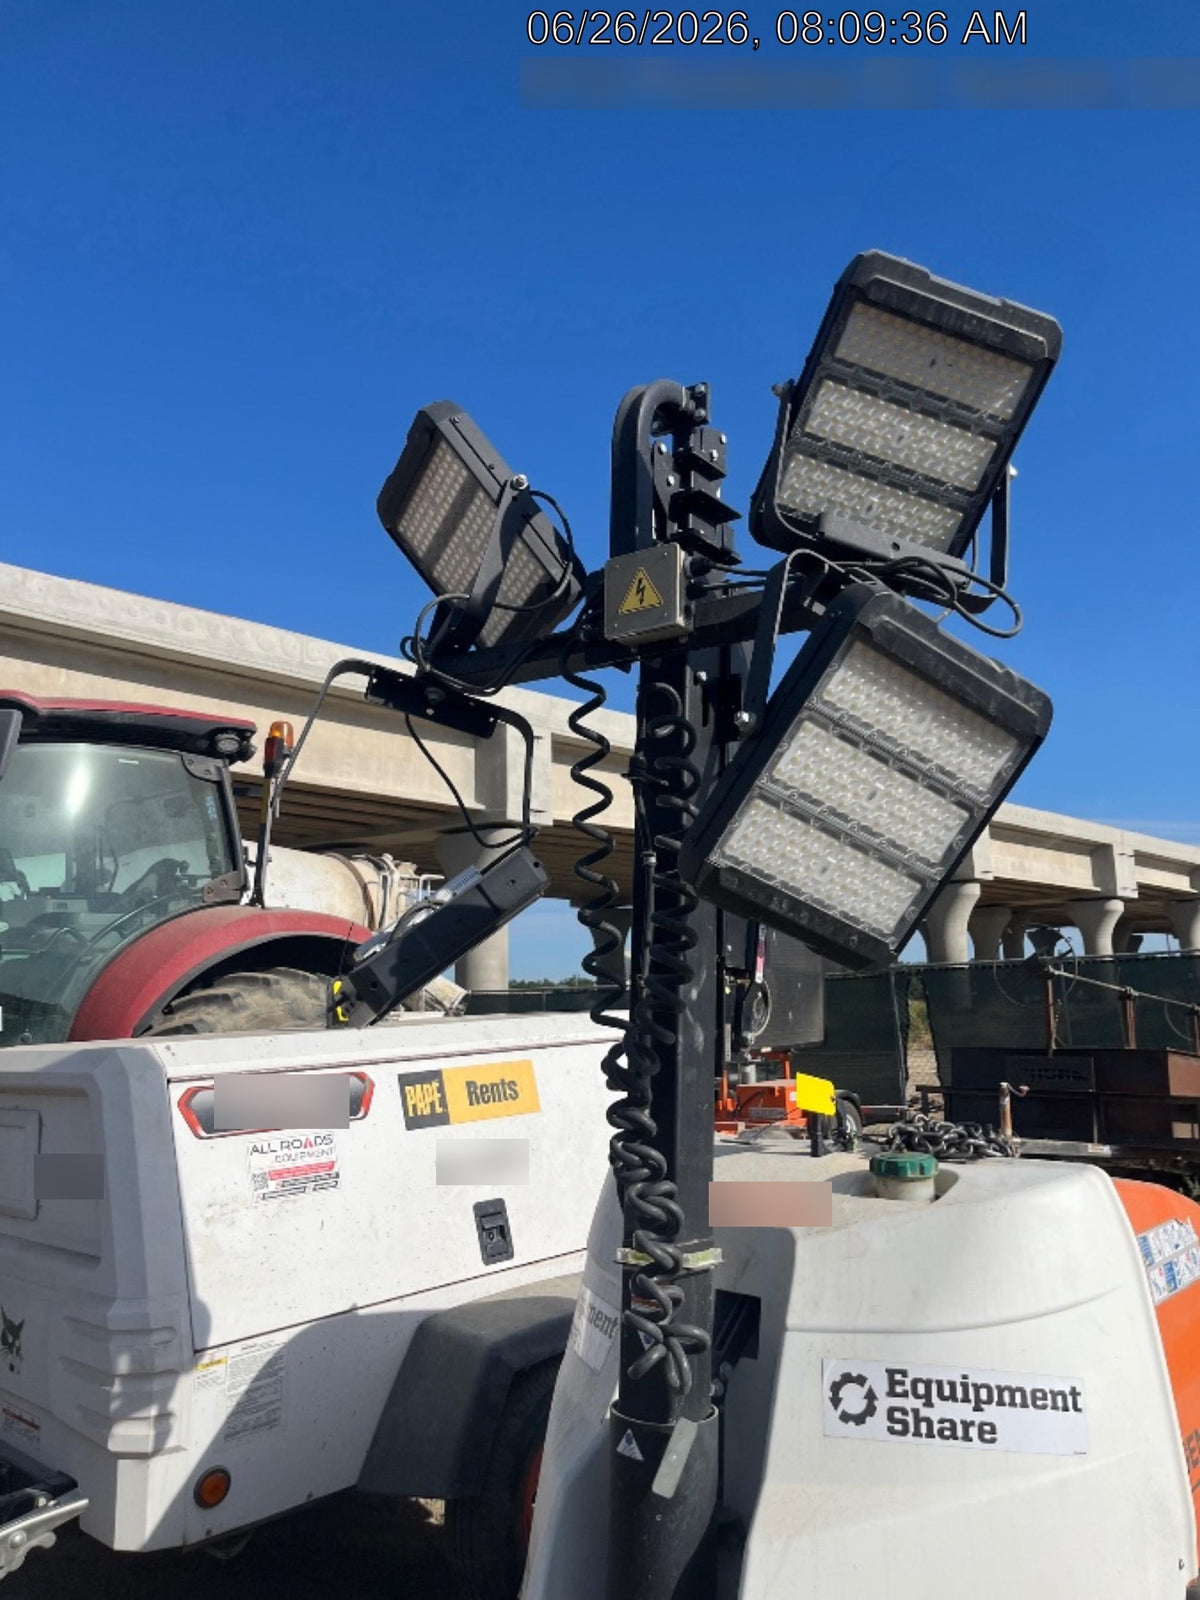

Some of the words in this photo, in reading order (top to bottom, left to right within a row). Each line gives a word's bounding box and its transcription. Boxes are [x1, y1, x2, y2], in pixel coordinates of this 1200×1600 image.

[465, 1078, 519, 1107] Rents
[250, 1142, 277, 1156] ALL
[280, 1133, 334, 1151] ROADS
[885, 1368, 1082, 1413] Equipment
[886, 1405, 998, 1444] Share
